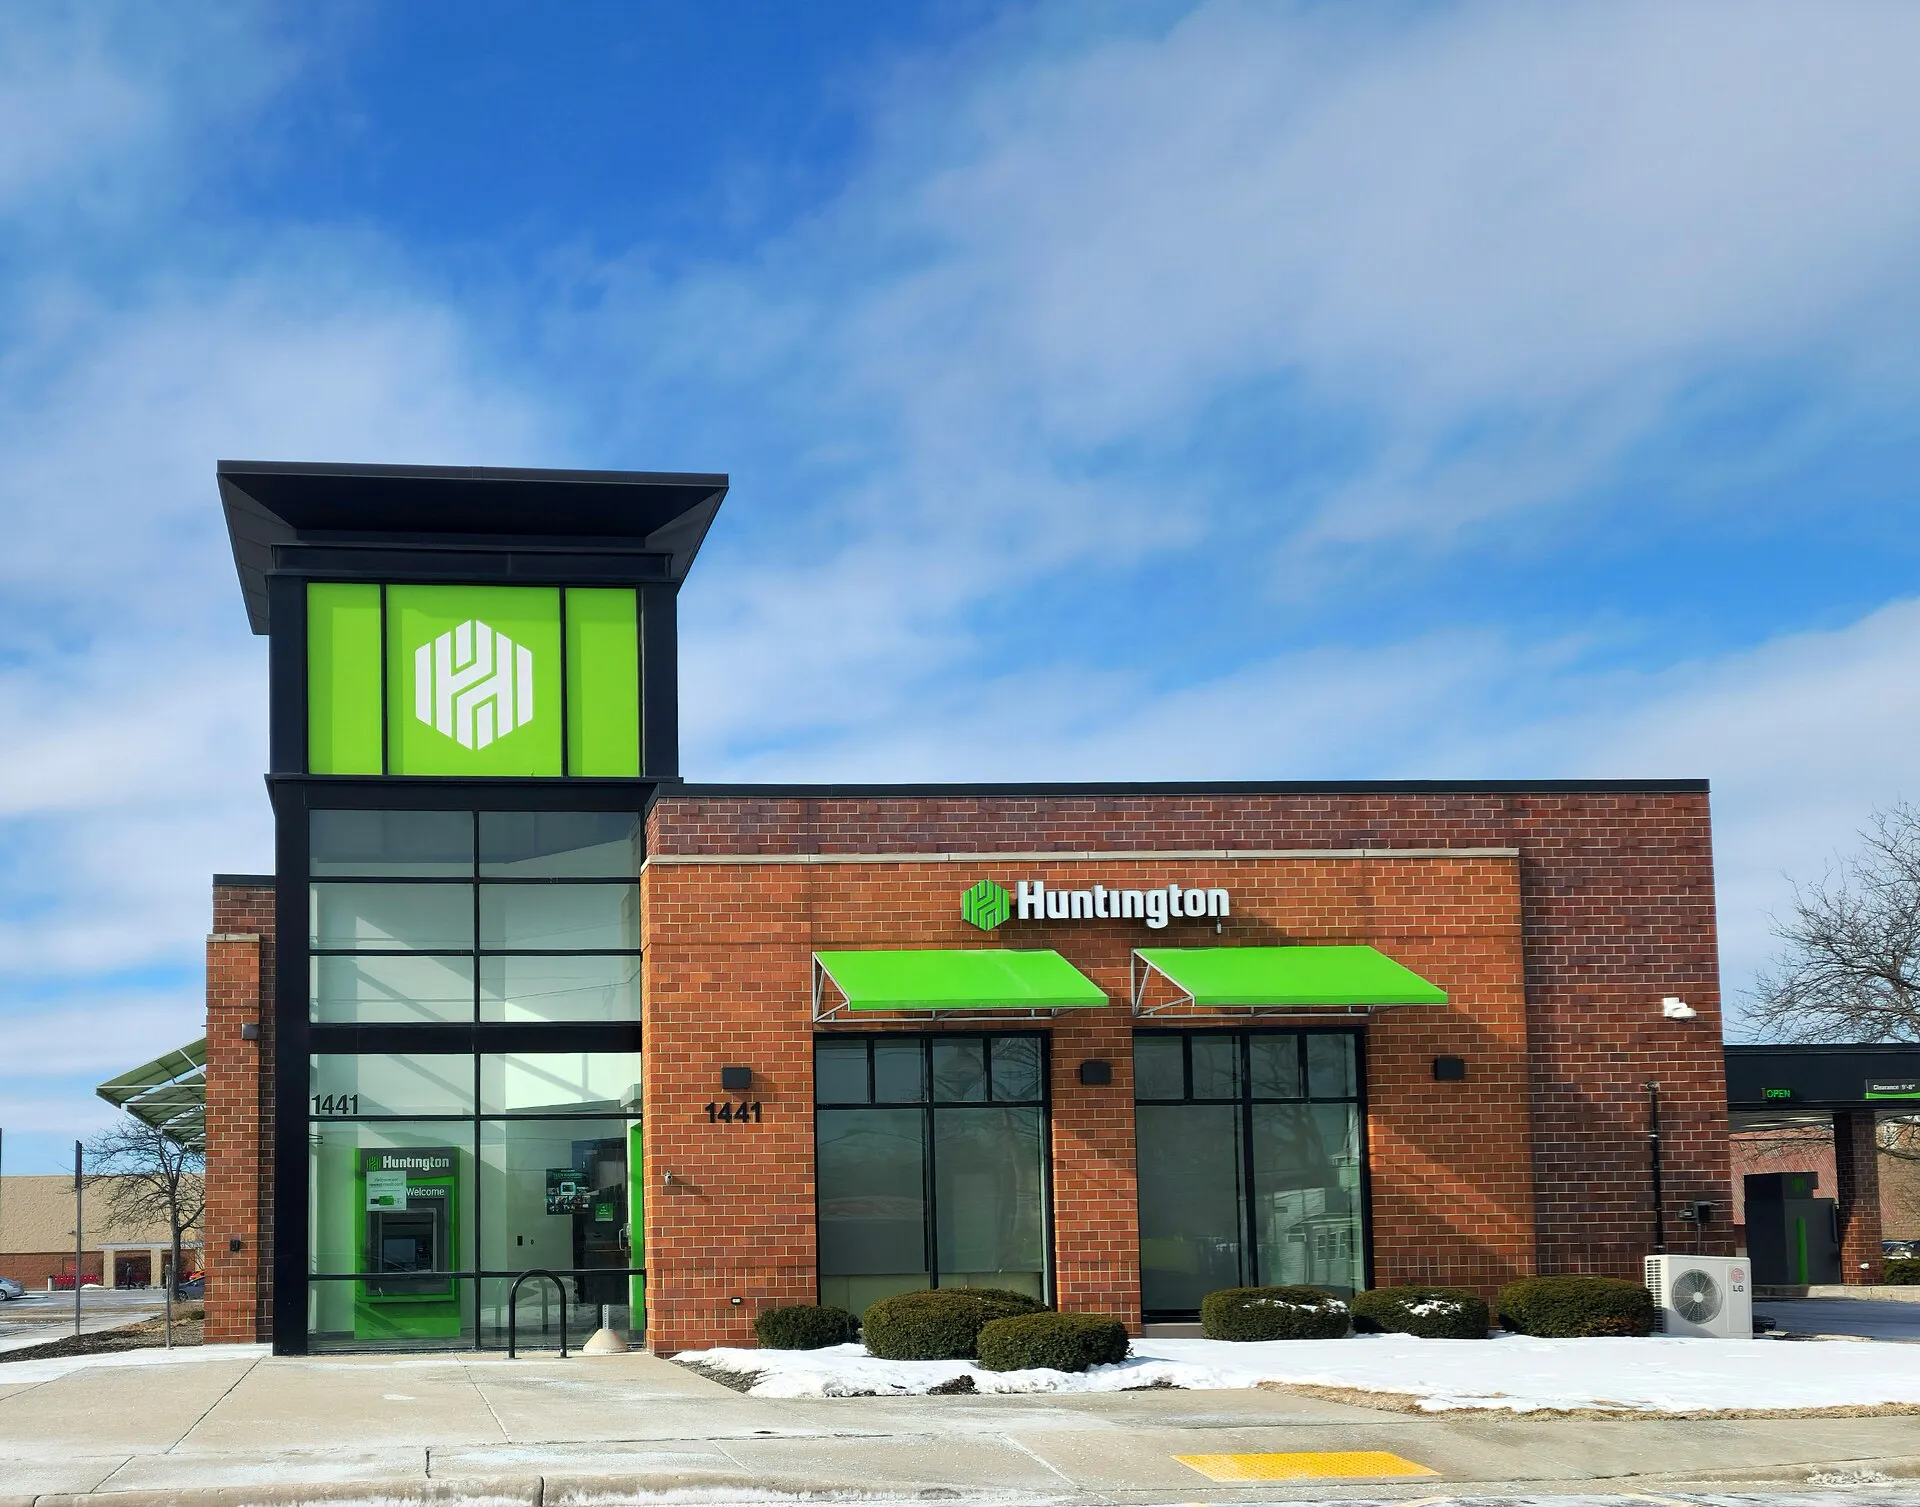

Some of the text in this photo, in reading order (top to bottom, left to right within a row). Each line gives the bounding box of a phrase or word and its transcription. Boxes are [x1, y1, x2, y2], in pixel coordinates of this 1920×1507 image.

[1016, 880, 1230, 929] Huntington
[1766, 1089, 1791, 1098] OPEN
[311, 1094, 358, 1115] 1441
[705, 1101, 761, 1123] 1441
[382, 1155, 450, 1171] Huntington
[406, 1187, 445, 1197] Welcome
